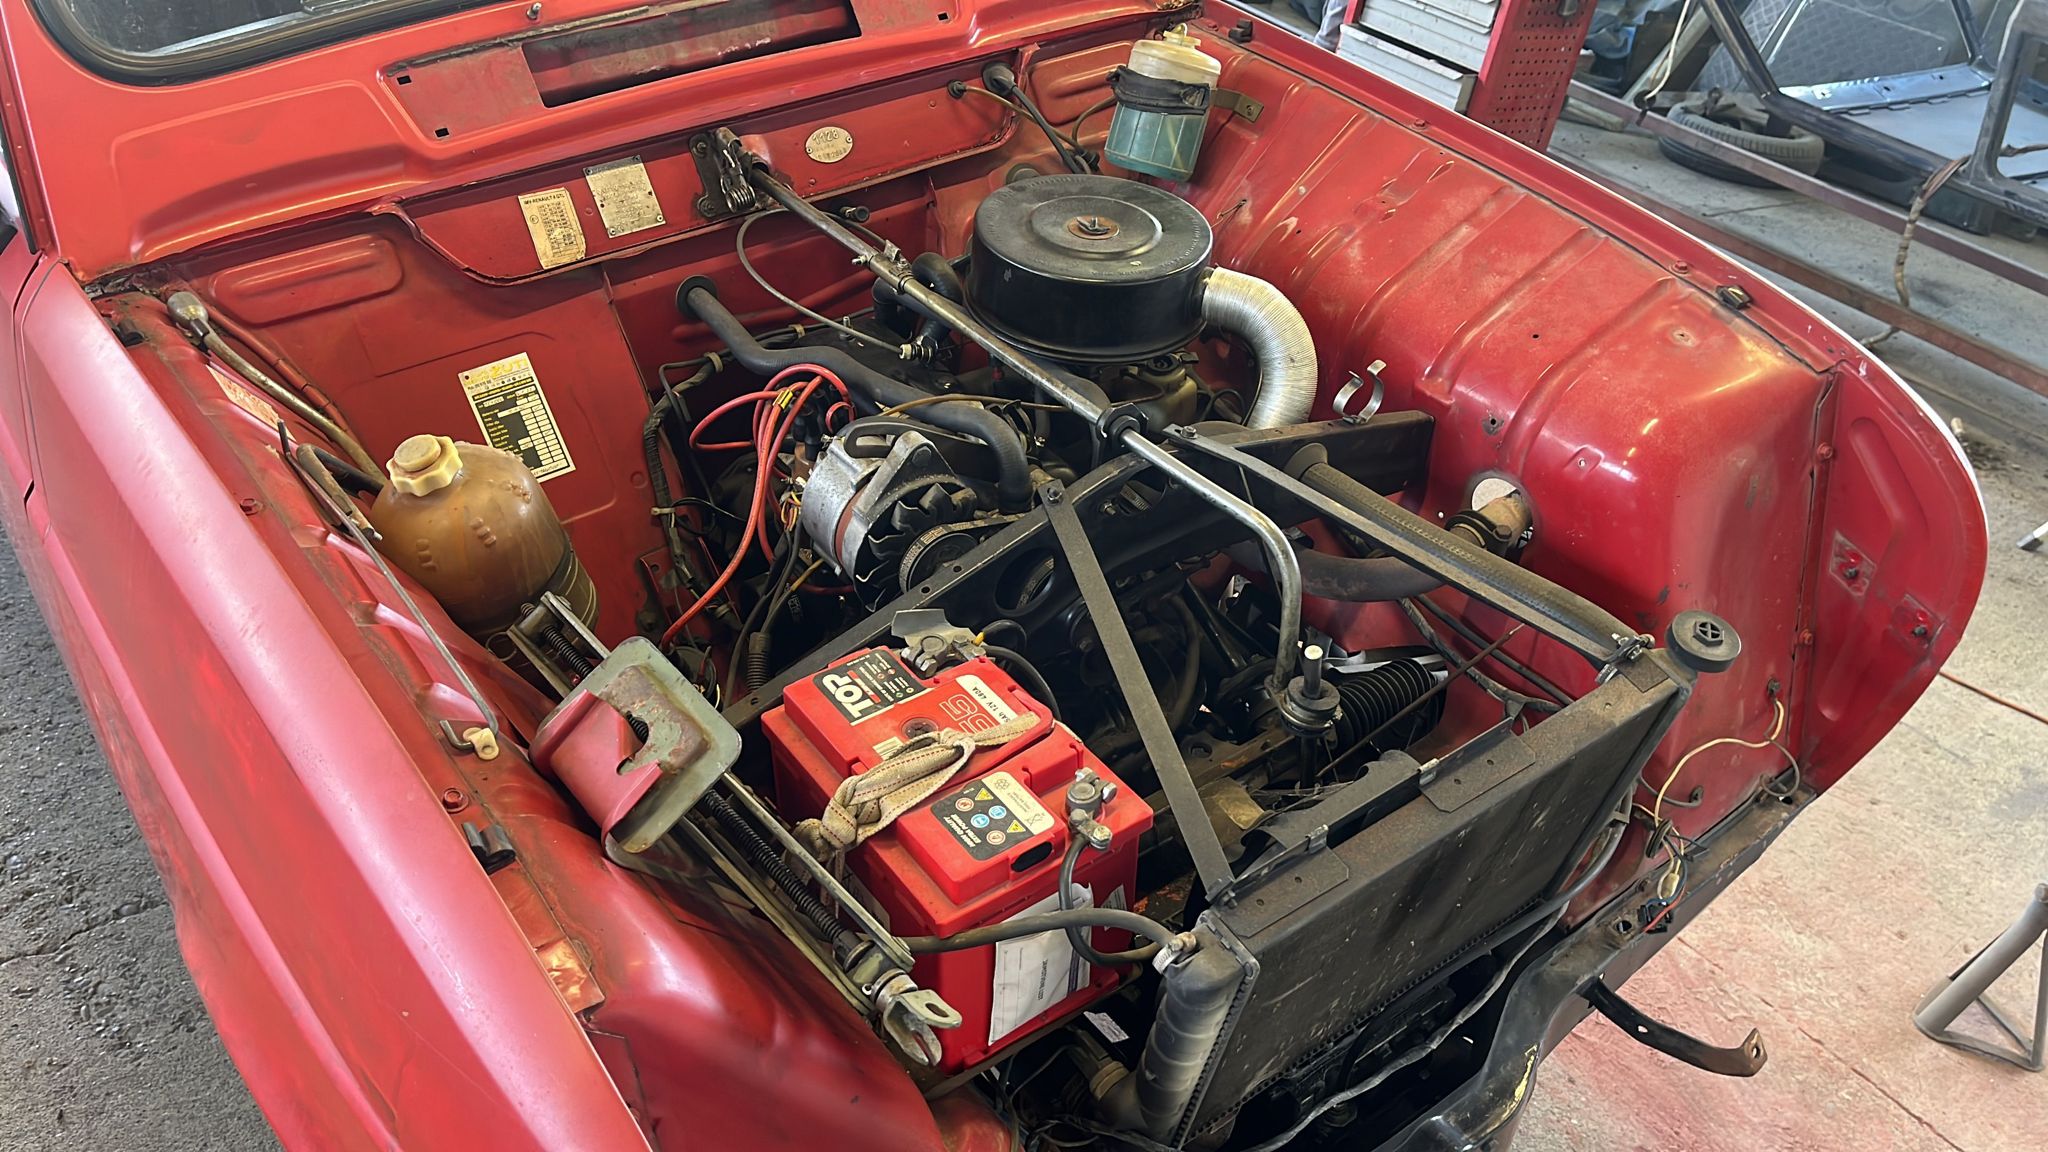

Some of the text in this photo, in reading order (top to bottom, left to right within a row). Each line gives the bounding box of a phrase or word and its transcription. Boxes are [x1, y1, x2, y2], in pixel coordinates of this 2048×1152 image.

[812, 129, 839, 145] 1128
[822, 674, 861, 718] TOP
[986, 701, 999, 712] 12V
[943, 816, 964, 836] QUALITY
[950, 813, 982, 844] EXTRA POWER
